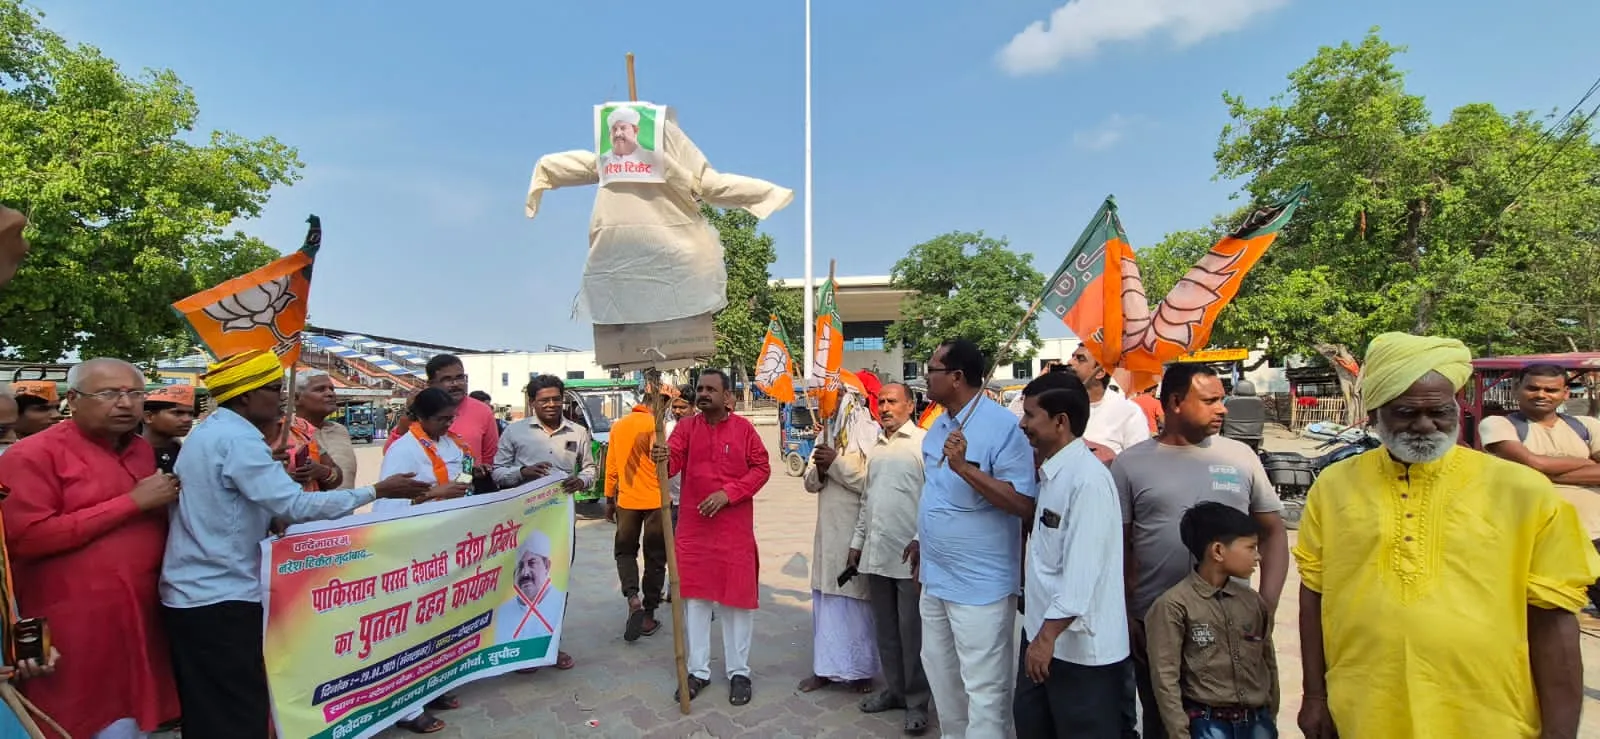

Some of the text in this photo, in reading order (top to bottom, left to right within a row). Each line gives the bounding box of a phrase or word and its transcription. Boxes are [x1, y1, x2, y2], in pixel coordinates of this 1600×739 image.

[278, 560, 302, 574] नरेश
[311, 576, 378, 611] पाकिस्तान
[381, 567, 409, 593] परस्त
[455, 532, 487, 568] नरेश
[334, 565, 503, 659] का पुतला दहन कार्यक्रम
[391, 684, 426, 709] भाजपा
[426, 667, 458, 689] किसान
[487, 646, 521, 665] सुपौल
